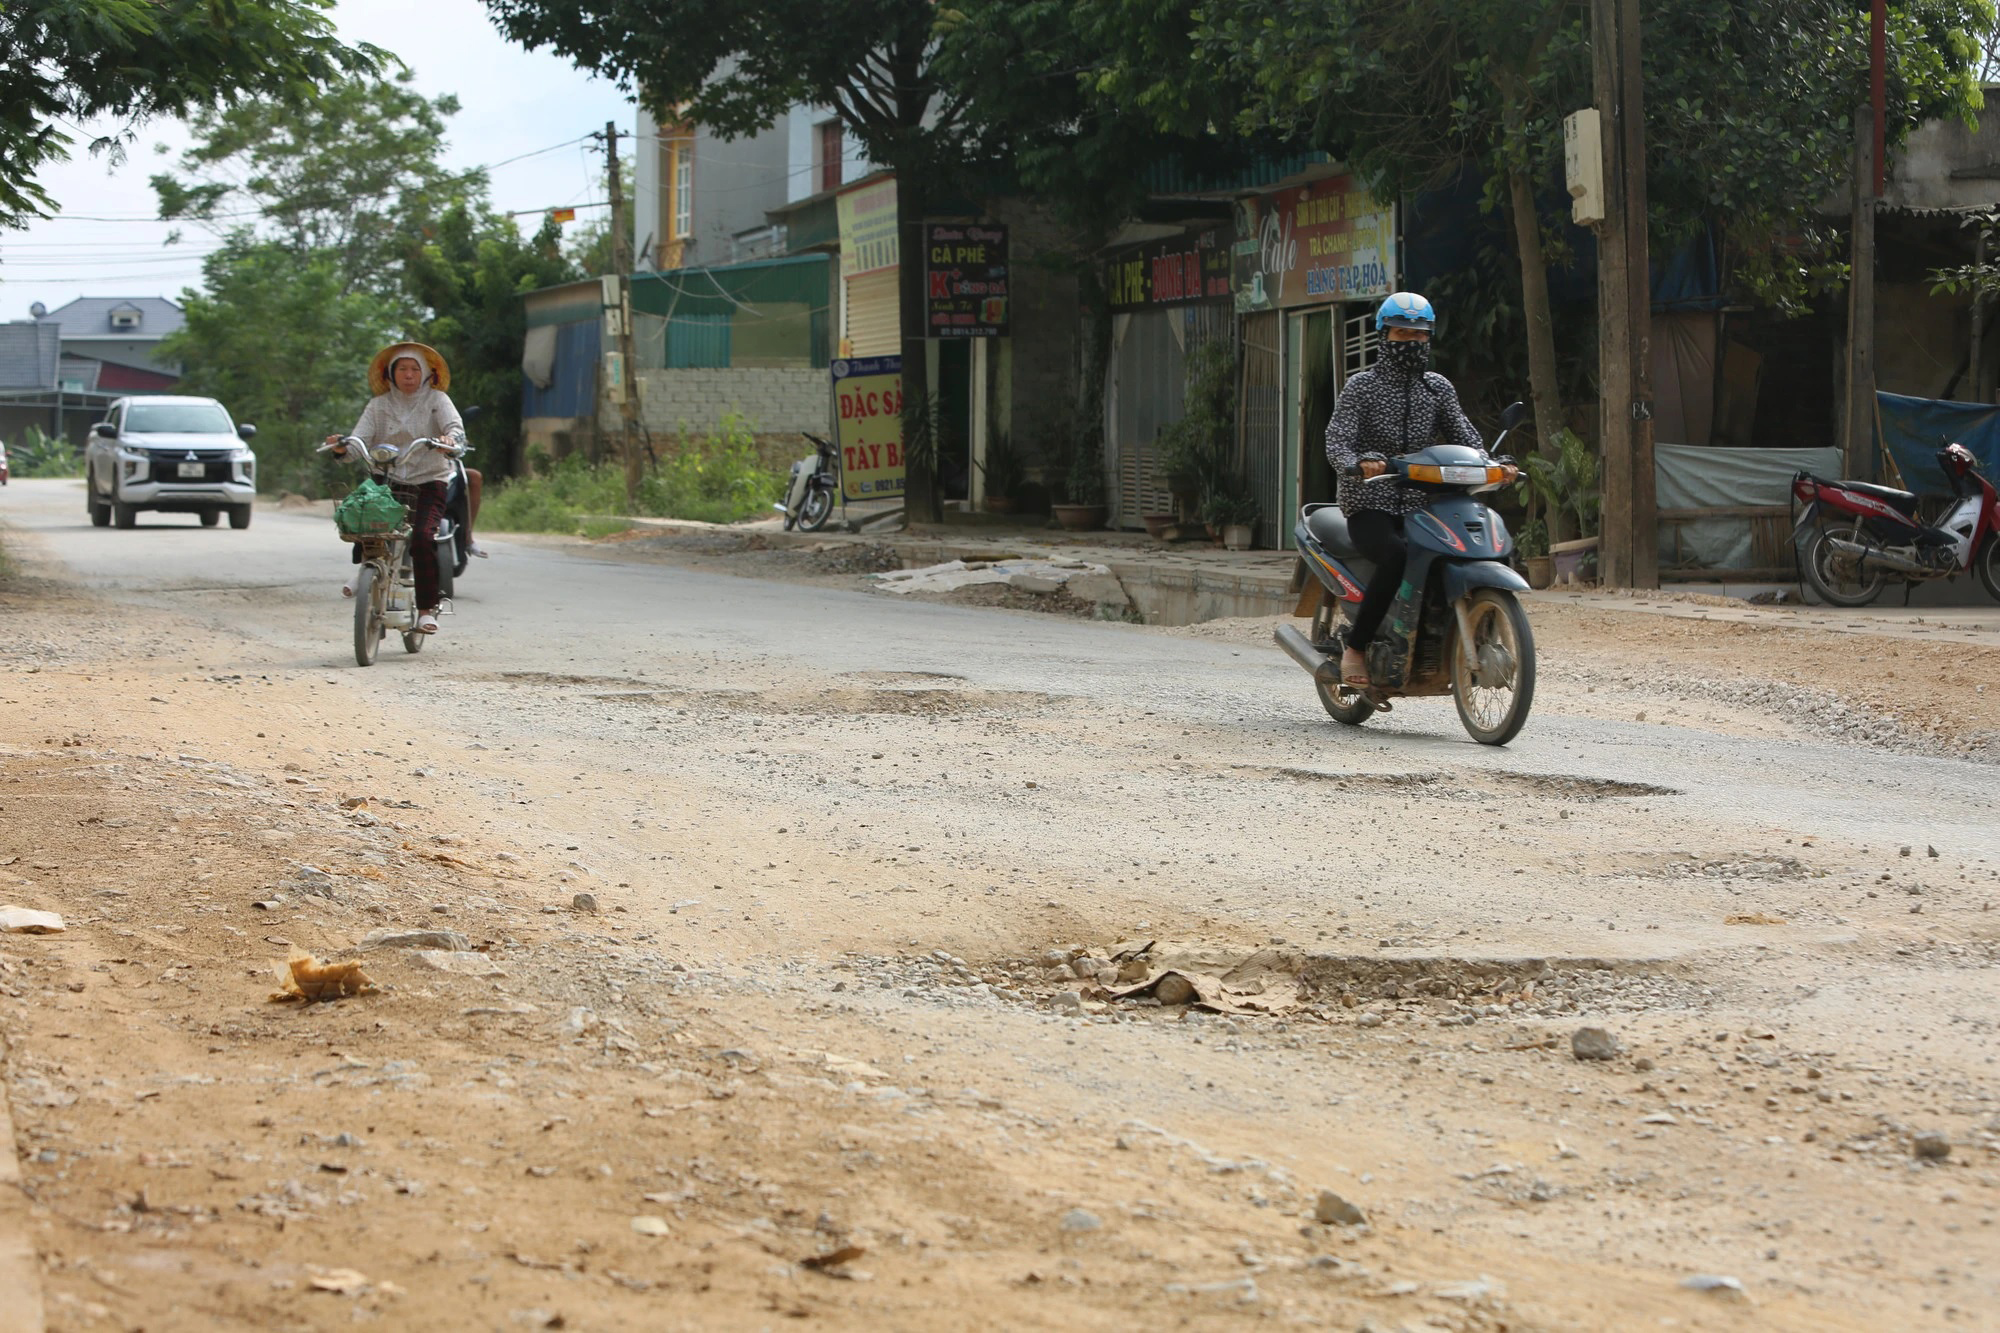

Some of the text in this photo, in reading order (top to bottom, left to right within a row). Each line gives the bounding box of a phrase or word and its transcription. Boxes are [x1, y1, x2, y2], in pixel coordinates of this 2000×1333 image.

[931, 244, 986, 264] CÀ PHÊ
[1323, 233, 1348, 256] CHANH
[1124, 251, 1145, 304] PHÊ
[1152, 245, 1183, 303] BÓNG
[1307, 262, 1337, 296] HÀNG
[1363, 256, 1387, 288] HÓA
[840, 379, 904, 425] ĐẶC SẢ
[844, 438, 881, 472] TÂY
[1336, 574, 1361, 597] SUZUKI
